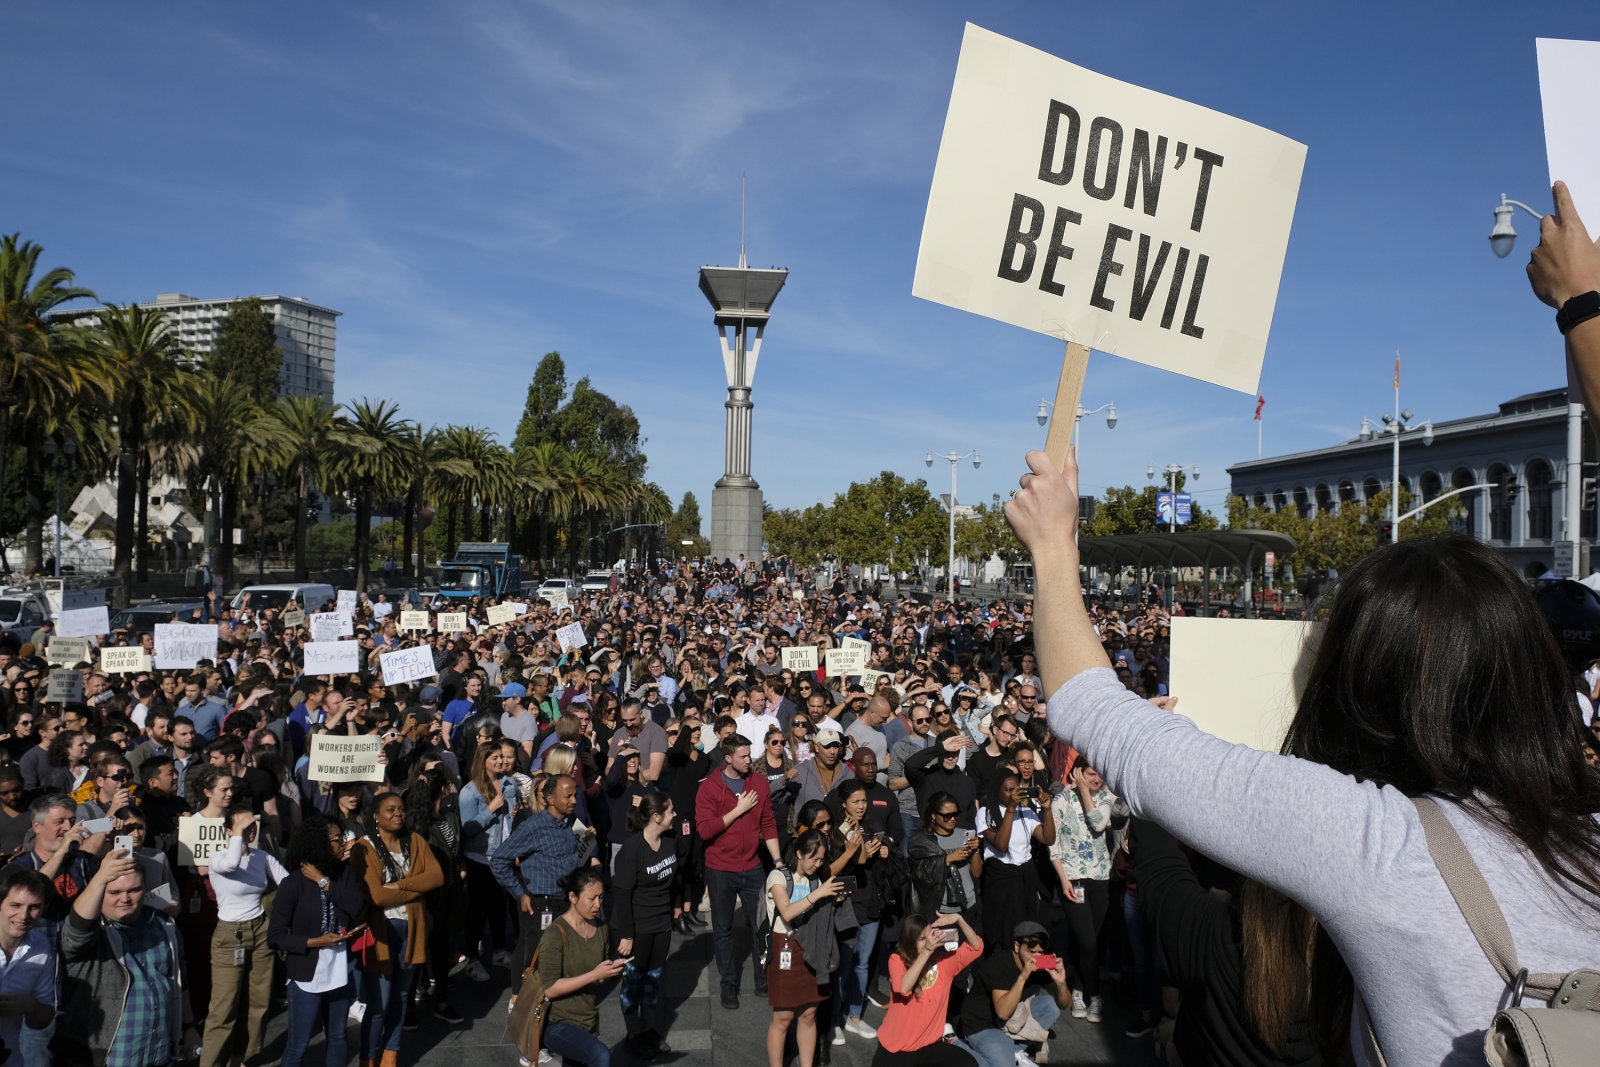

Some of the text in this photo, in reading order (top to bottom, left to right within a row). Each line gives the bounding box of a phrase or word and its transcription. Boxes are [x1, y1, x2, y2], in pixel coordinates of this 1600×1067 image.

[1038, 98, 1225, 233] DON'T
[997, 192, 1210, 340] BE EVIL
[314, 613, 340, 623] MAKE
[444, 615, 460, 623] DON'T
[1562, 629, 1593, 641] PYLE
[384, 651, 419, 668] TIME'S
[790, 650, 809, 659] DON'T
[105, 661, 125, 669] SPEAK
[788, 659, 811, 668] BE EVIL
[384, 661, 433, 683] UP TECH
[318, 742, 379, 753] WORKERS RIGHTS
[341, 755, 355, 764] ARE
[318, 765, 376, 775] WOMENS RIGHTS
[199, 825, 227, 841] DON
[193, 844, 210, 859] BE
